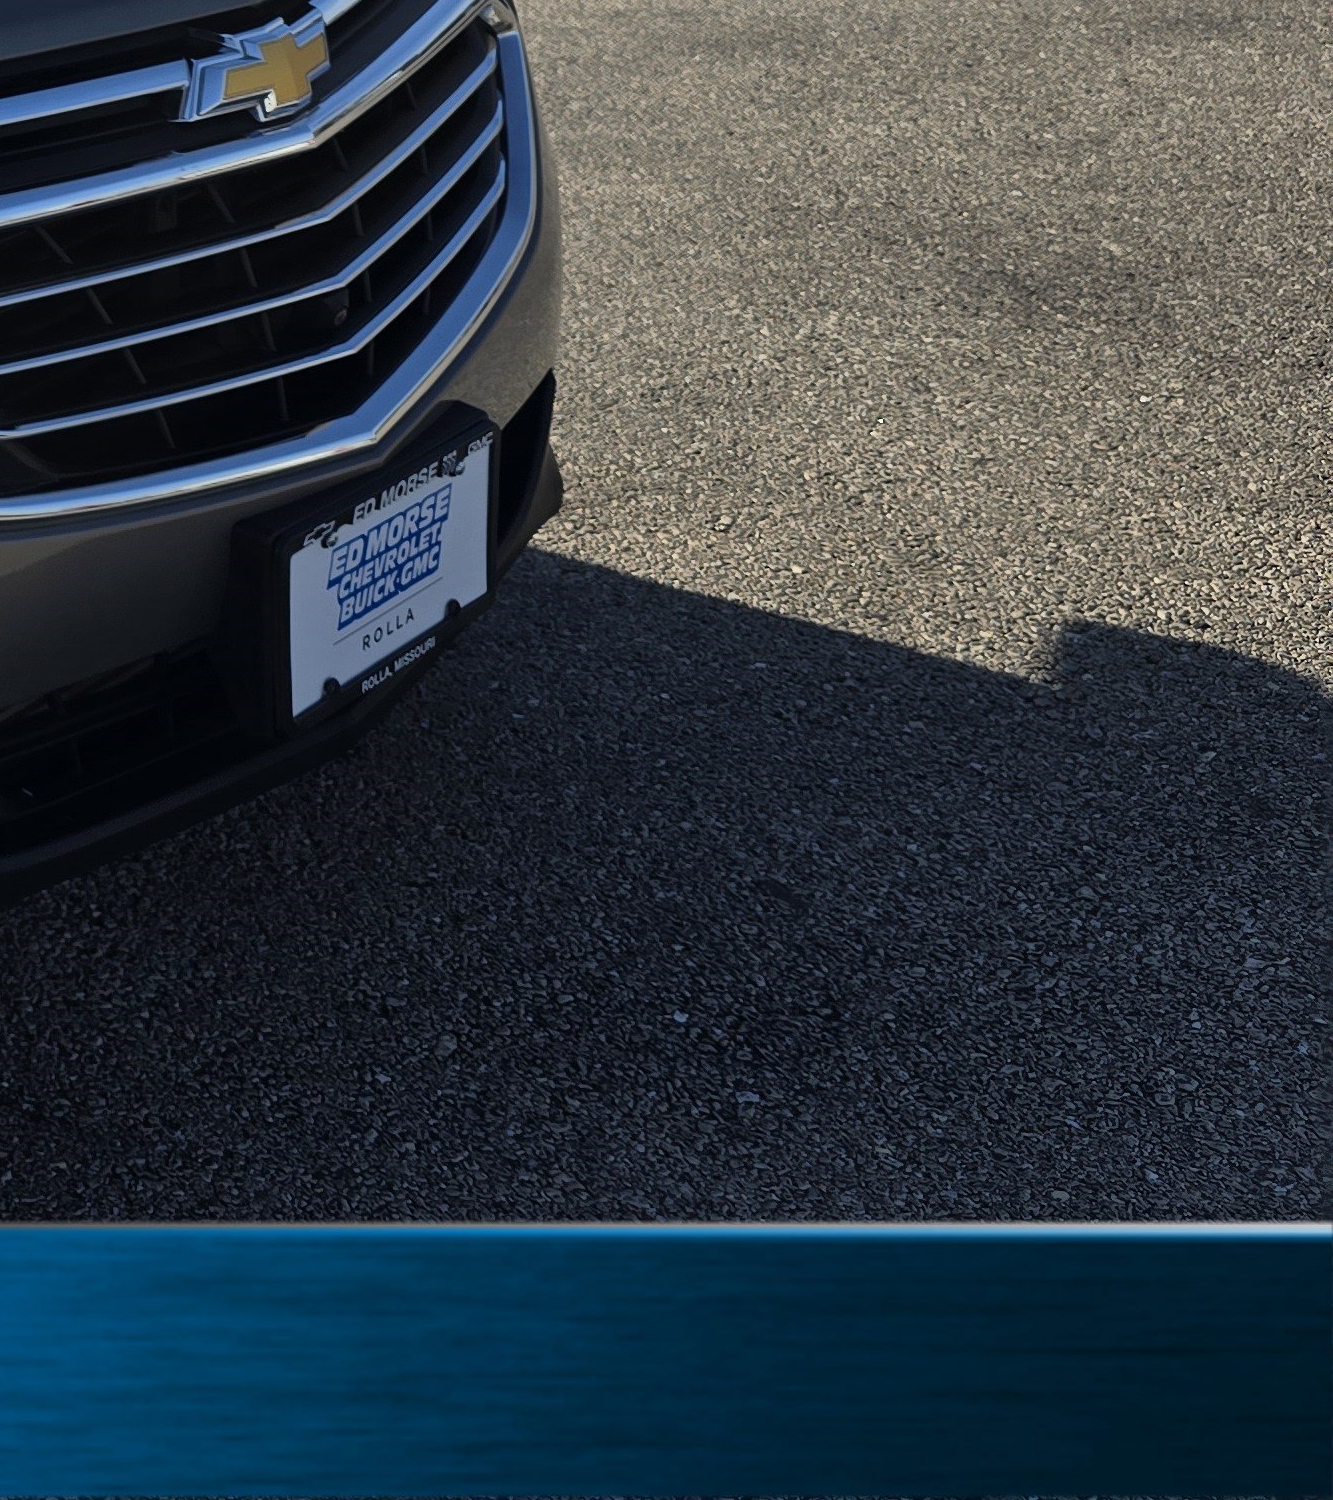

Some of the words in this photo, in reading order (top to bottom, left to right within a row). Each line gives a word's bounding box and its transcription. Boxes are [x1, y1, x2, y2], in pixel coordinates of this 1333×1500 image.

[354, 497, 376, 521] ED
[380, 460, 439, 508] MORSE
[329, 536, 365, 582] ED
[366, 486, 451, 561] MORSE
[362, 607, 415, 651] ROLLA
[394, 636, 436, 672] MISSOURI
